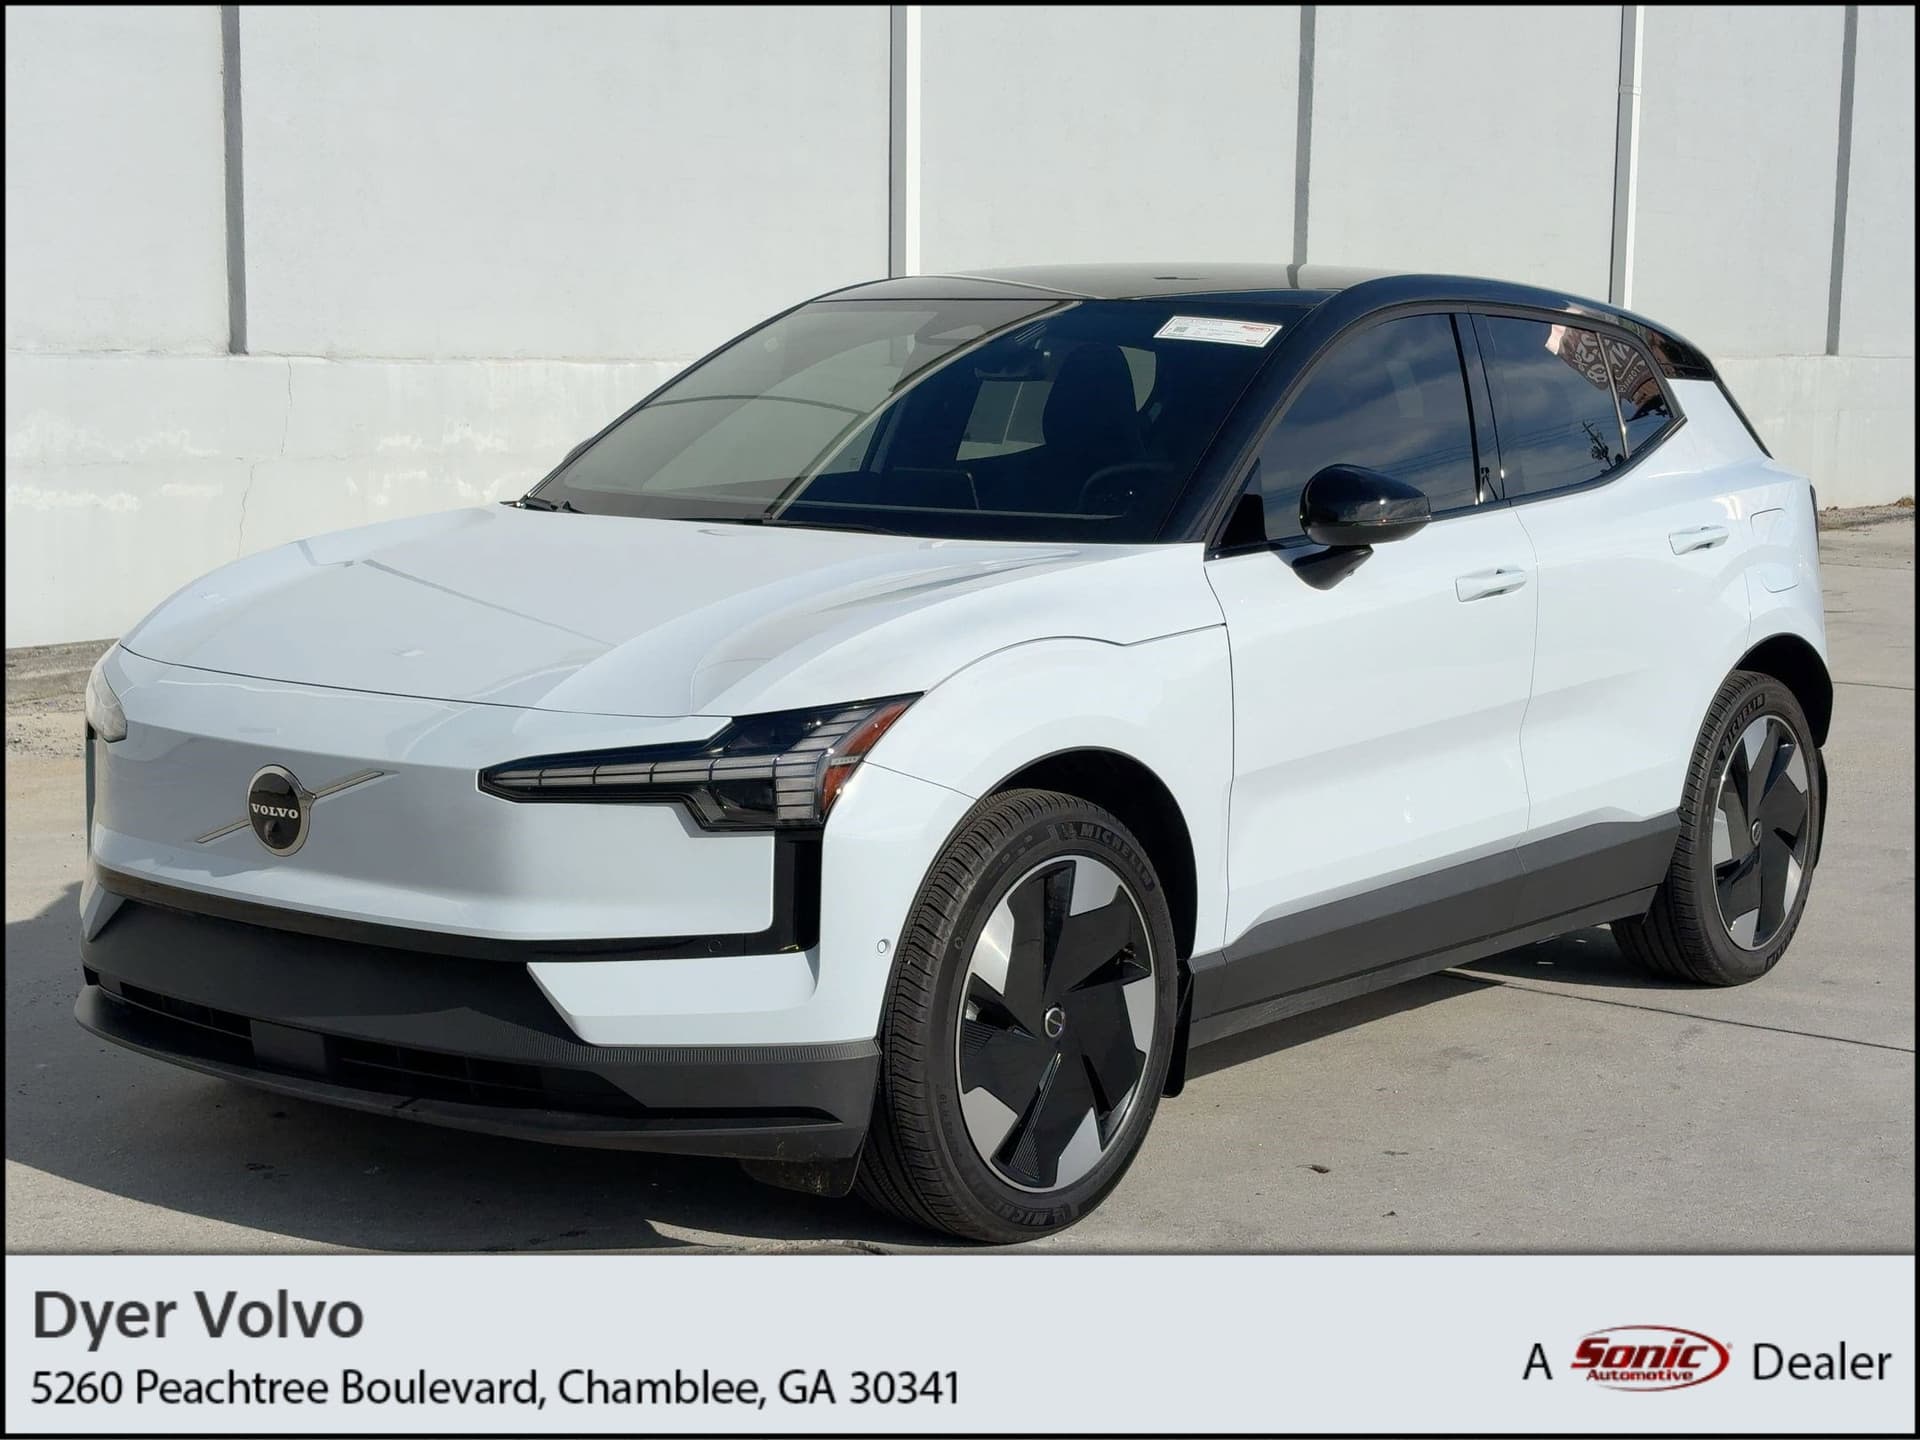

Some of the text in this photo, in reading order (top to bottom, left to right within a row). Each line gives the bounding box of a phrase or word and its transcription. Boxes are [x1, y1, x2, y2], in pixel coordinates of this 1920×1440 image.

[1722, 694, 1764, 756] MICHELIN
[250, 803, 299, 819] VOLVO
[1080, 823, 1153, 886] MICHELIN
